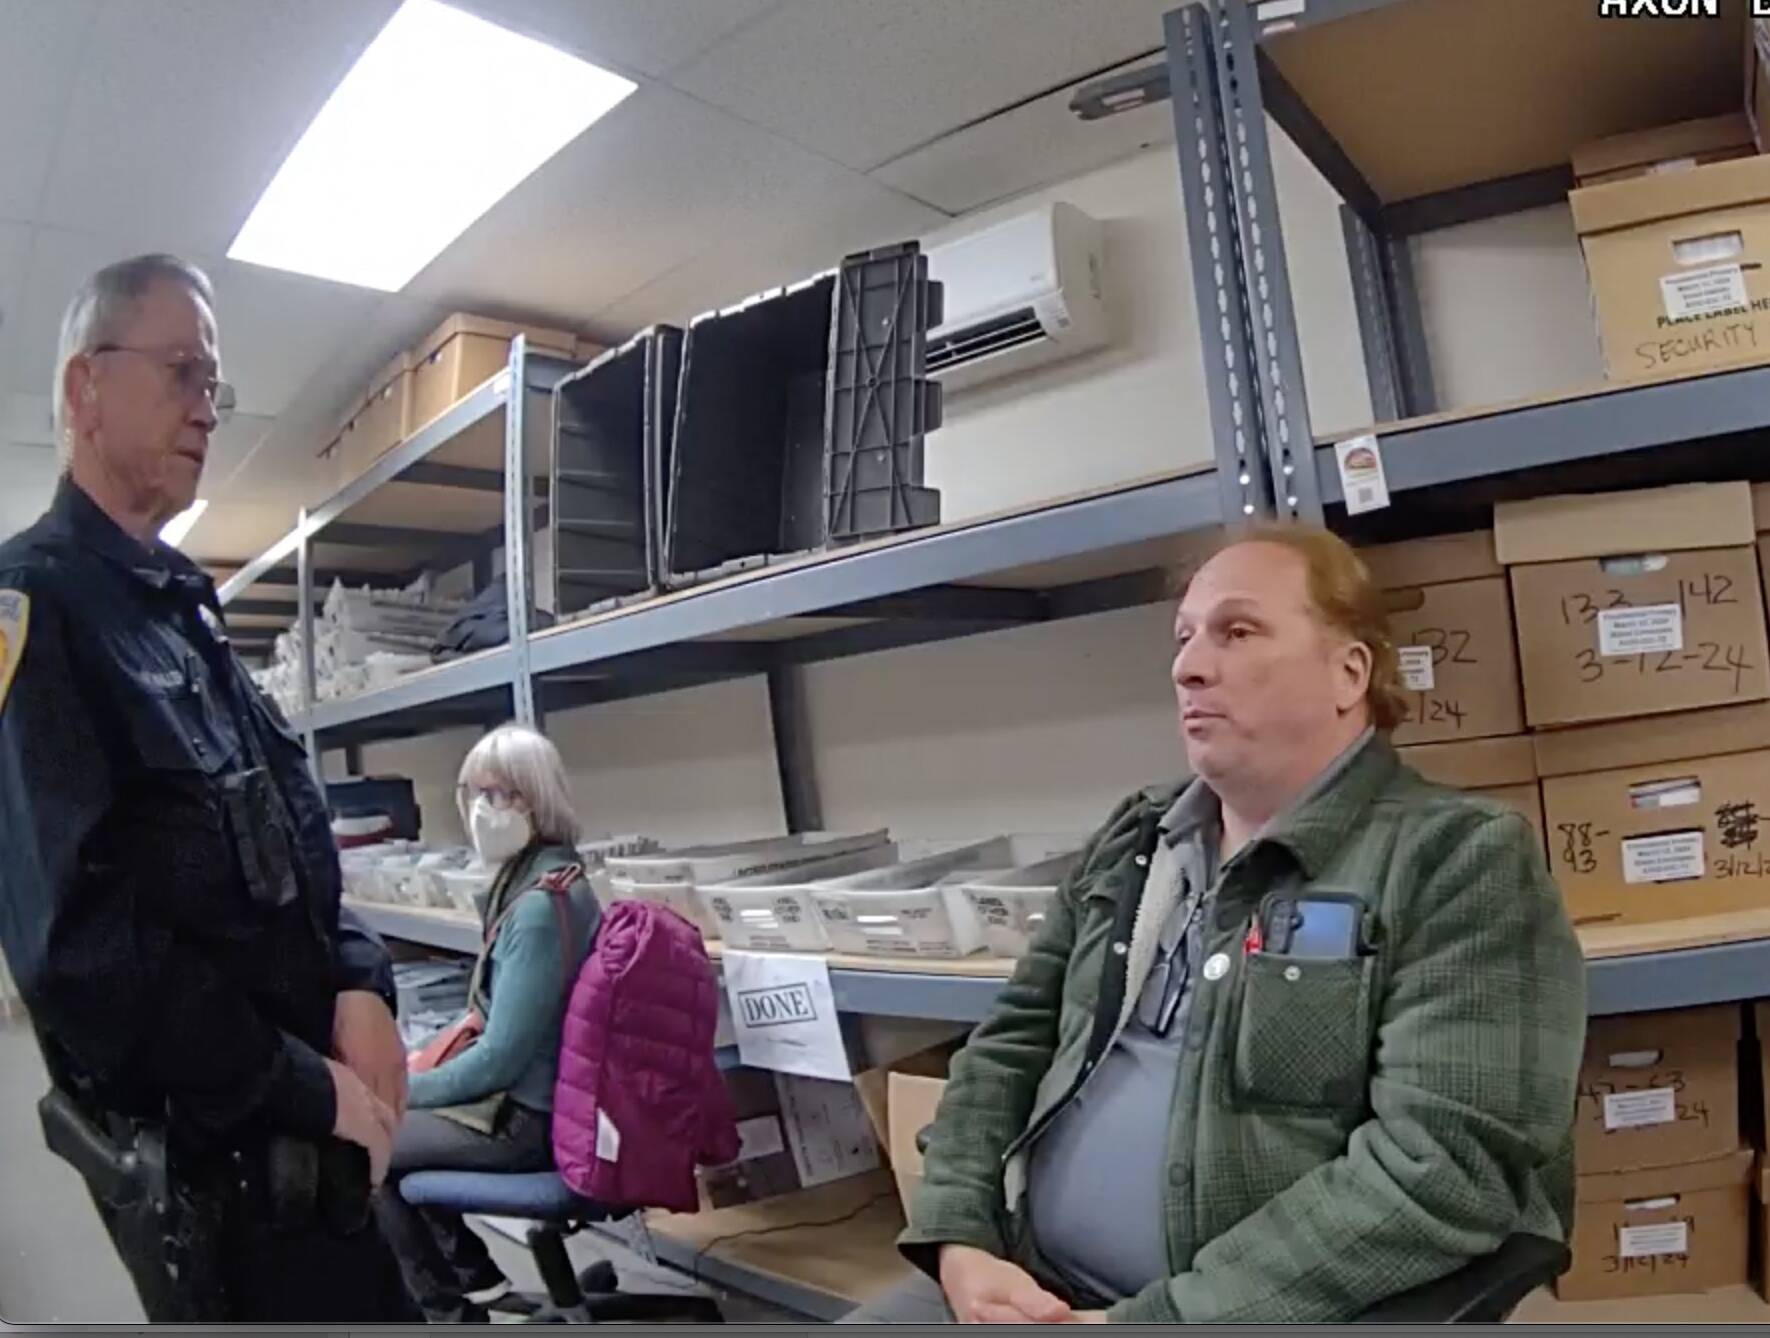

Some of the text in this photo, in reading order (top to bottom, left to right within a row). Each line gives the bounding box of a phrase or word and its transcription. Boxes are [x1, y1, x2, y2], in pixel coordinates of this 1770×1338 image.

[1635, 322, 1757, 369] SECURITY
[1679, 573, 1738, 620] 142
[745, 990, 809, 1021] DONE
